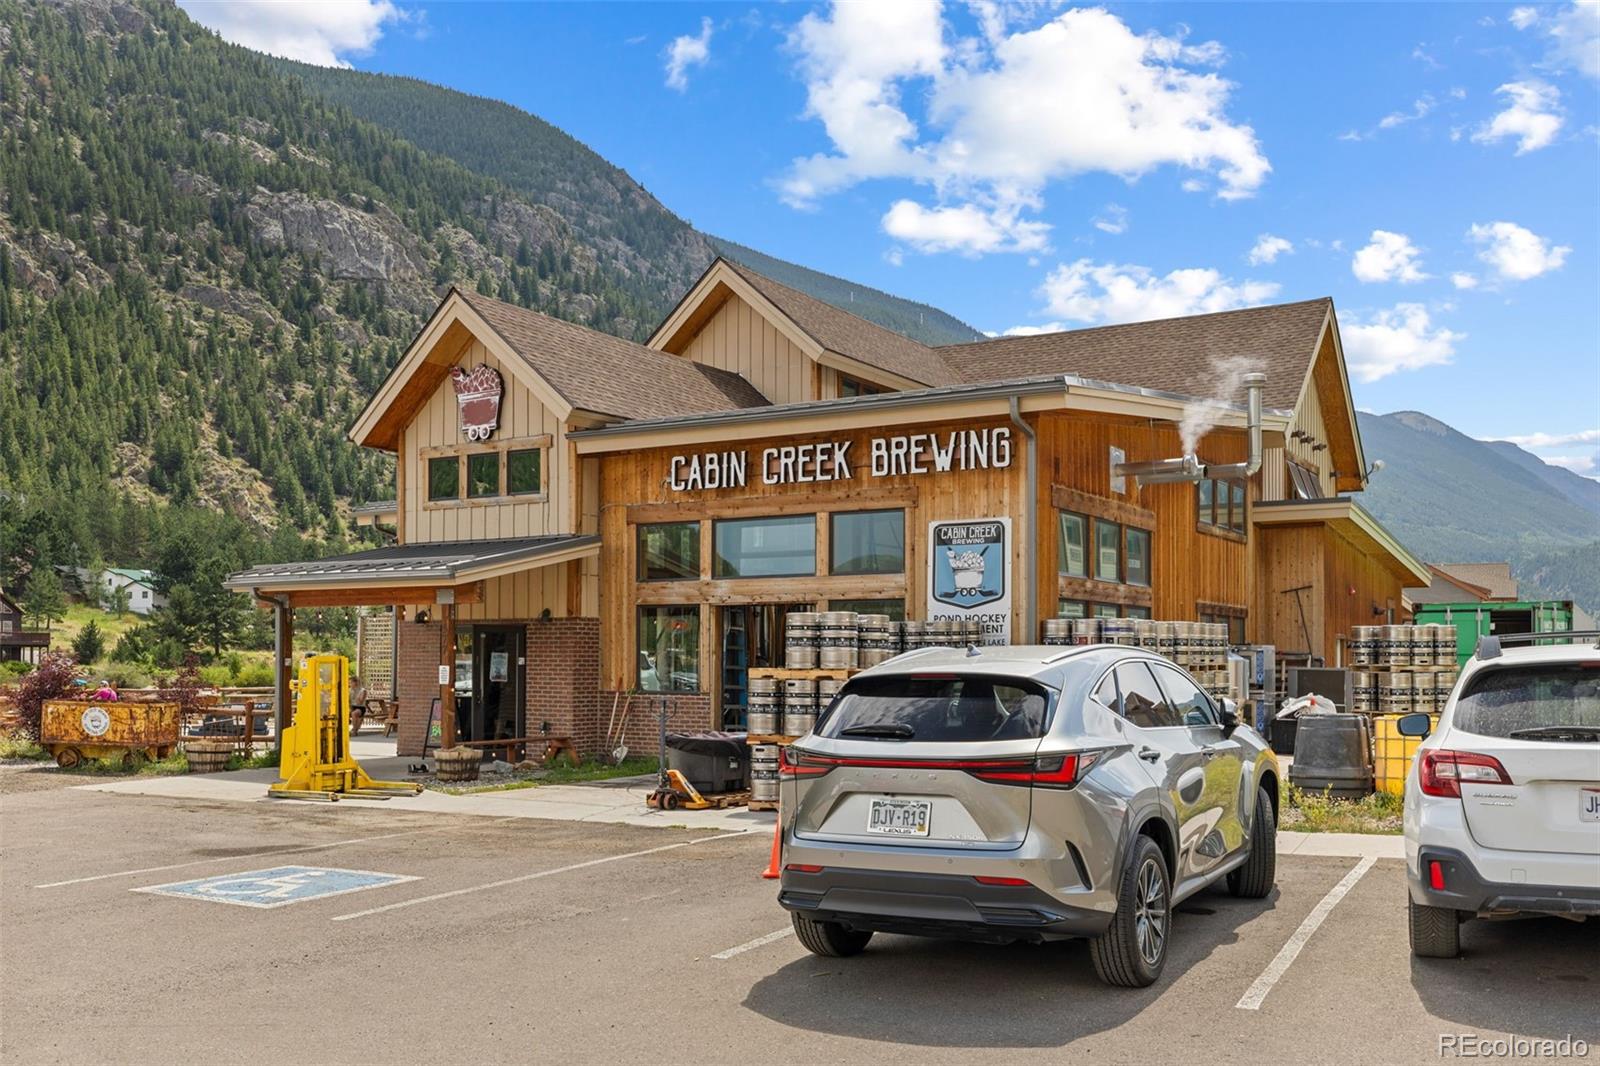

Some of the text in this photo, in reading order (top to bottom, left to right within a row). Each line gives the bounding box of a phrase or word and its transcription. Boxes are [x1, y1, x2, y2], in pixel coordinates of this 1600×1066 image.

[671, 427, 1012, 491] CABIN CREEK BREWING
[941, 525, 997, 539] CABIN CREEK
[965, 613, 1007, 624] HOCKEY
[987, 638, 1006, 646] LAKE
